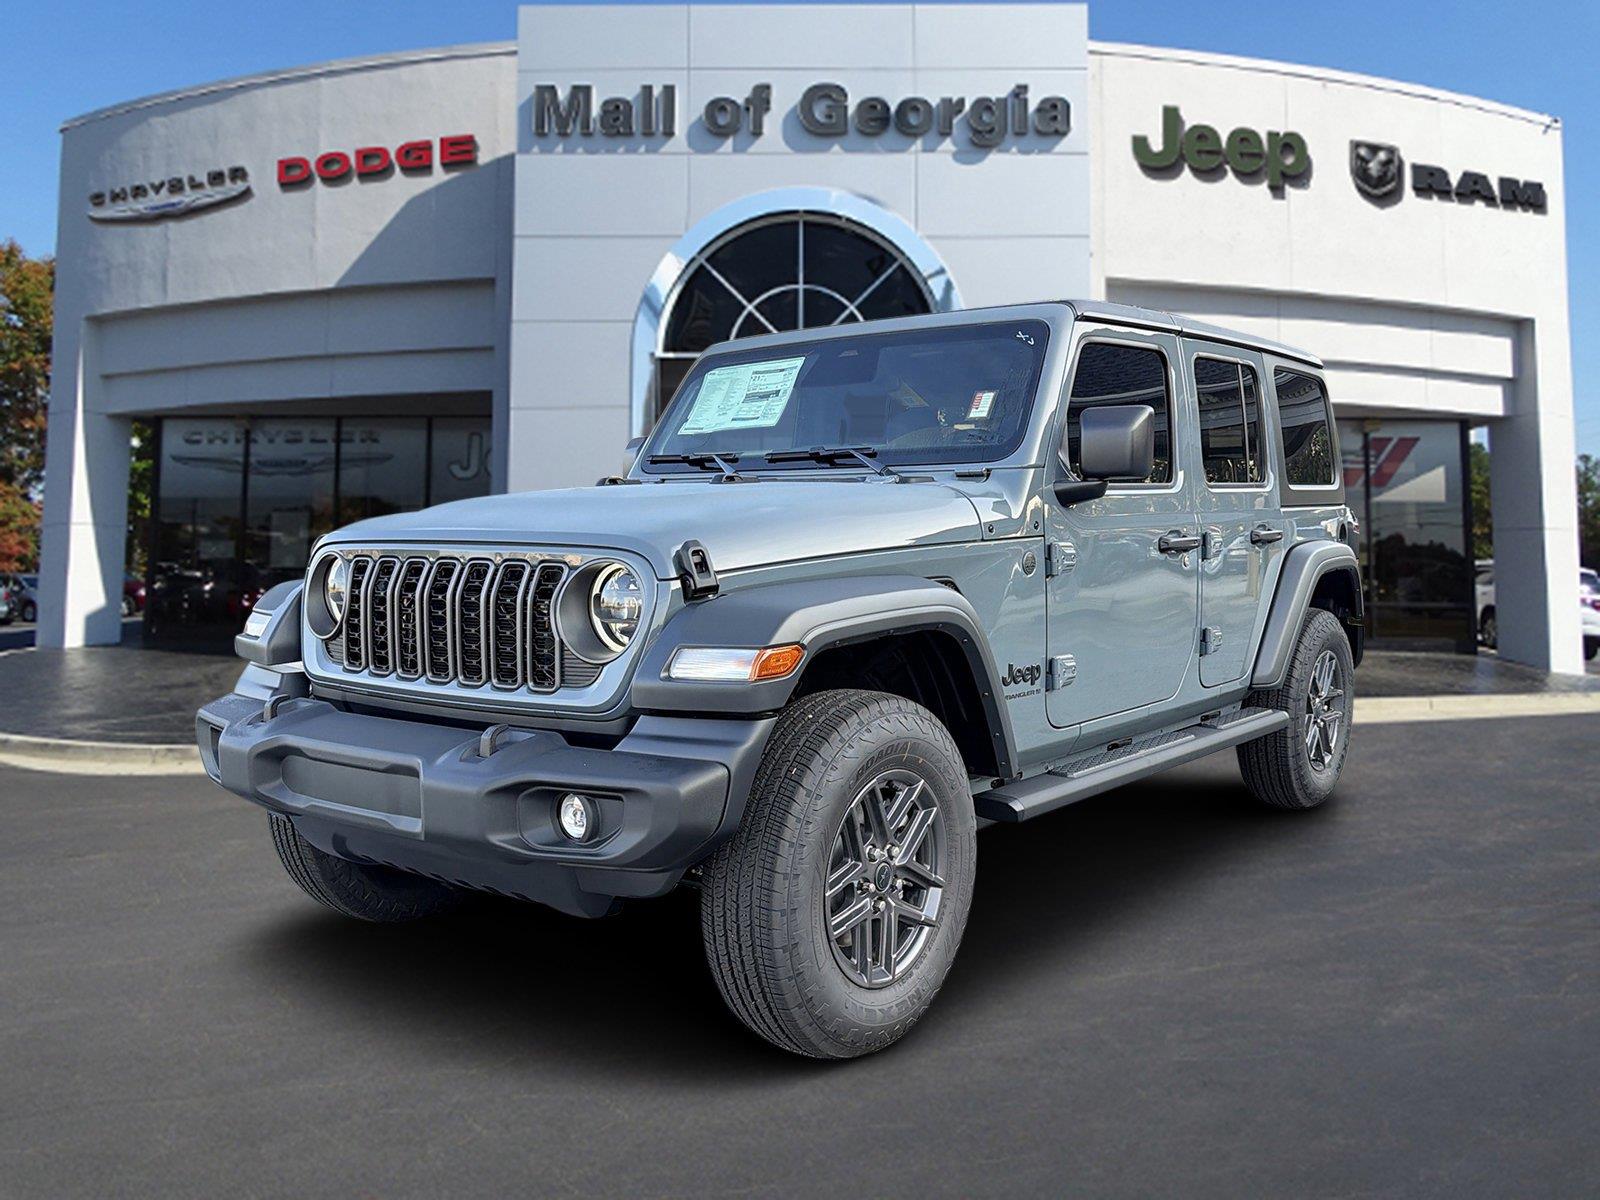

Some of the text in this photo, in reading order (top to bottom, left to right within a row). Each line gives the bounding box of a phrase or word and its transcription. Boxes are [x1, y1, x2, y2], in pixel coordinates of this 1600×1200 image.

[533, 83, 1072, 147] Mall of Georgia
[277, 134, 477, 185] DODGE
[1132, 105, 1308, 188] Jeep
[90, 166, 248, 206] CHRYSLER
[1411, 163, 1546, 211] RAM
[448, 432, 493, 481] J
[1002, 663, 1041, 686] Jeep
